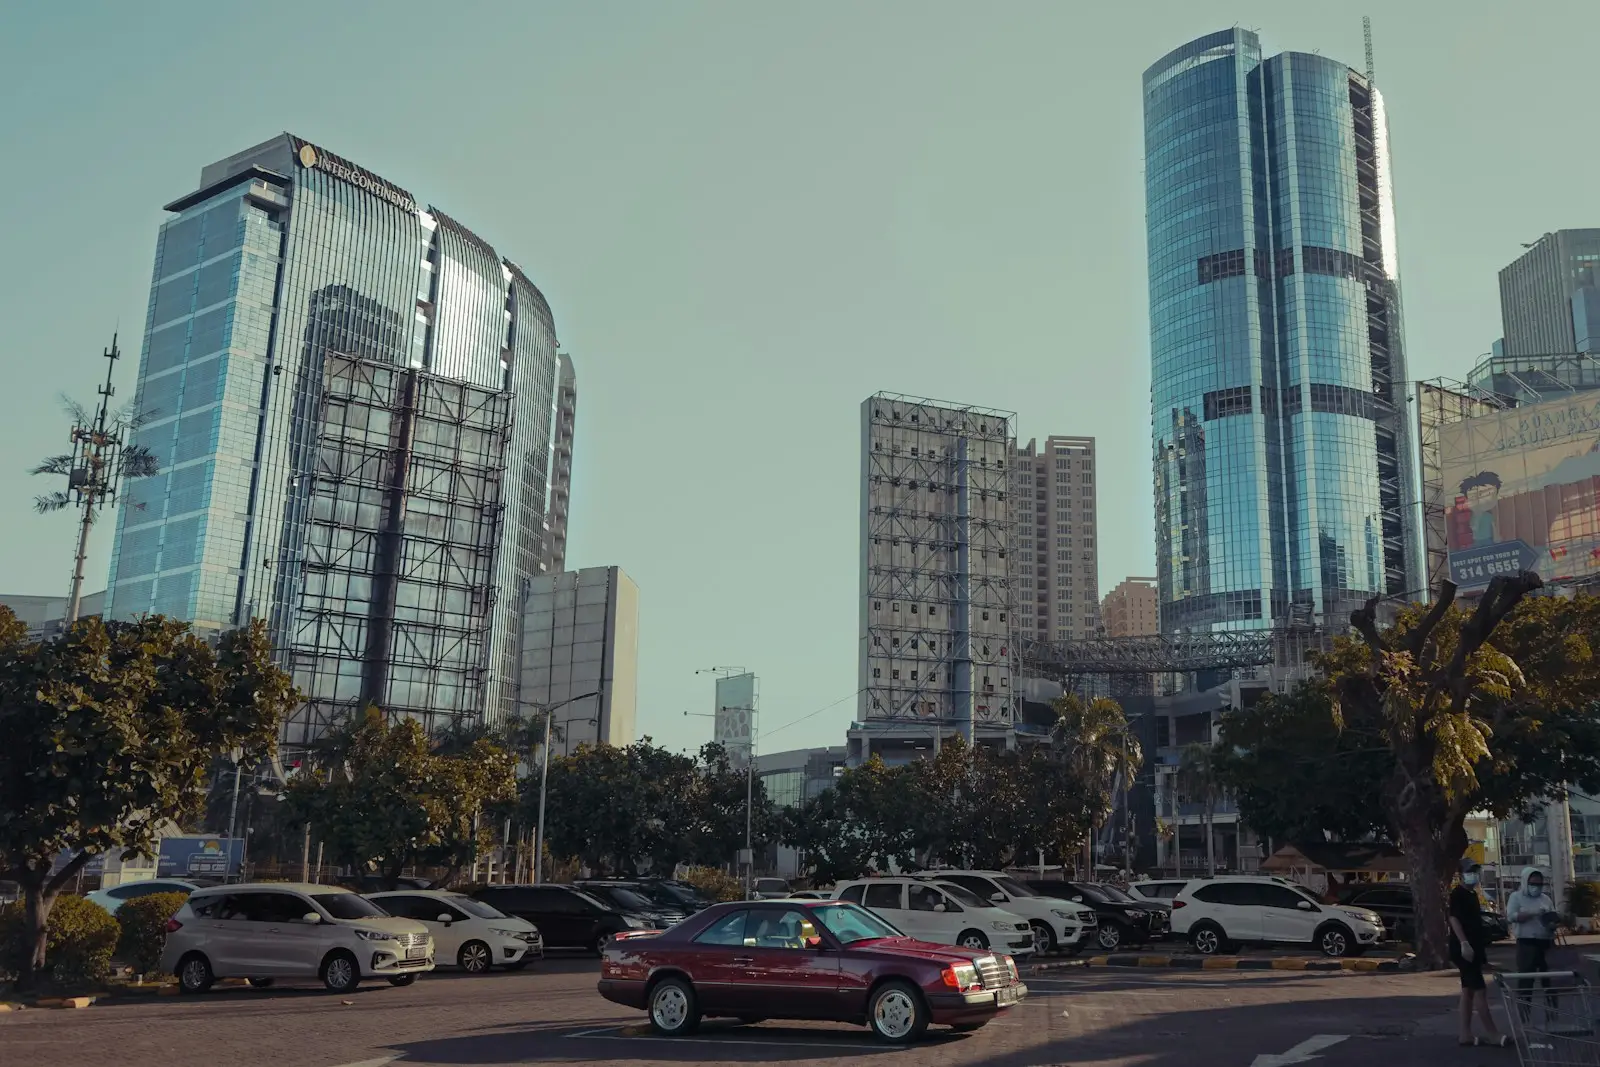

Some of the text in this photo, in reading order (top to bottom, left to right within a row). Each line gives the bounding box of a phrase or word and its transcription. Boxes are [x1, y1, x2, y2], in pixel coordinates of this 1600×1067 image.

[318, 155, 420, 215] INTERCONTINENTAL
[1495, 551, 1511, 560] YOUR
[1459, 558, 1521, 580] 314 6555
[1234, 671, 1240, 679] 5
